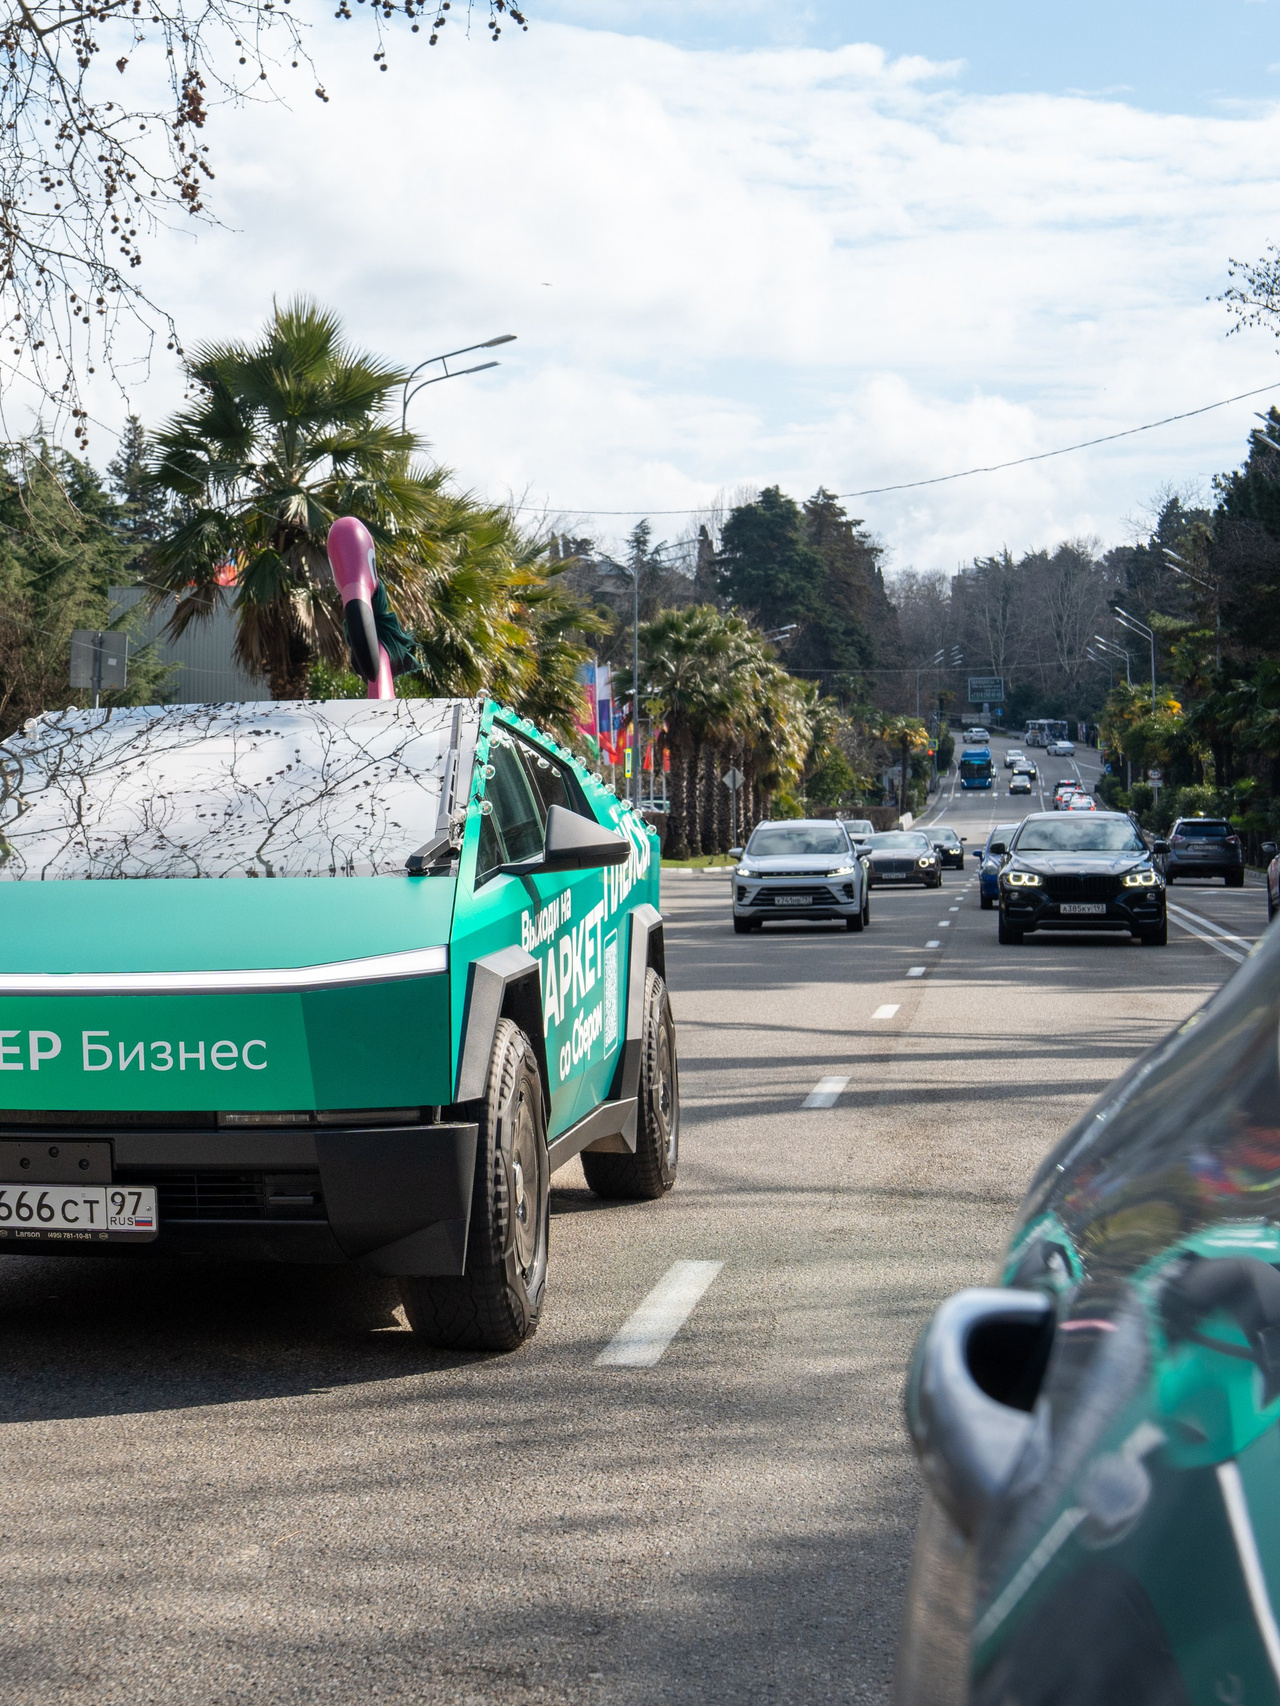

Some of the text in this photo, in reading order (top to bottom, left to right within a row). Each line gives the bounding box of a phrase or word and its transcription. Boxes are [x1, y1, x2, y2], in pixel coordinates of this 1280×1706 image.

[521, 888, 572, 952] Выходи на
[538, 899, 604, 1039] АРКЕТ
[81, 1030, 268, 1072] Бизнес
[559, 1001, 603, 1081] со Сбером
[110, 1191, 143, 1216] 97
[110, 1216, 134, 1226] RUS
[15, 1230, 41, 1238] Larson
[63, 1232, 92, 1240] 781-10-81
